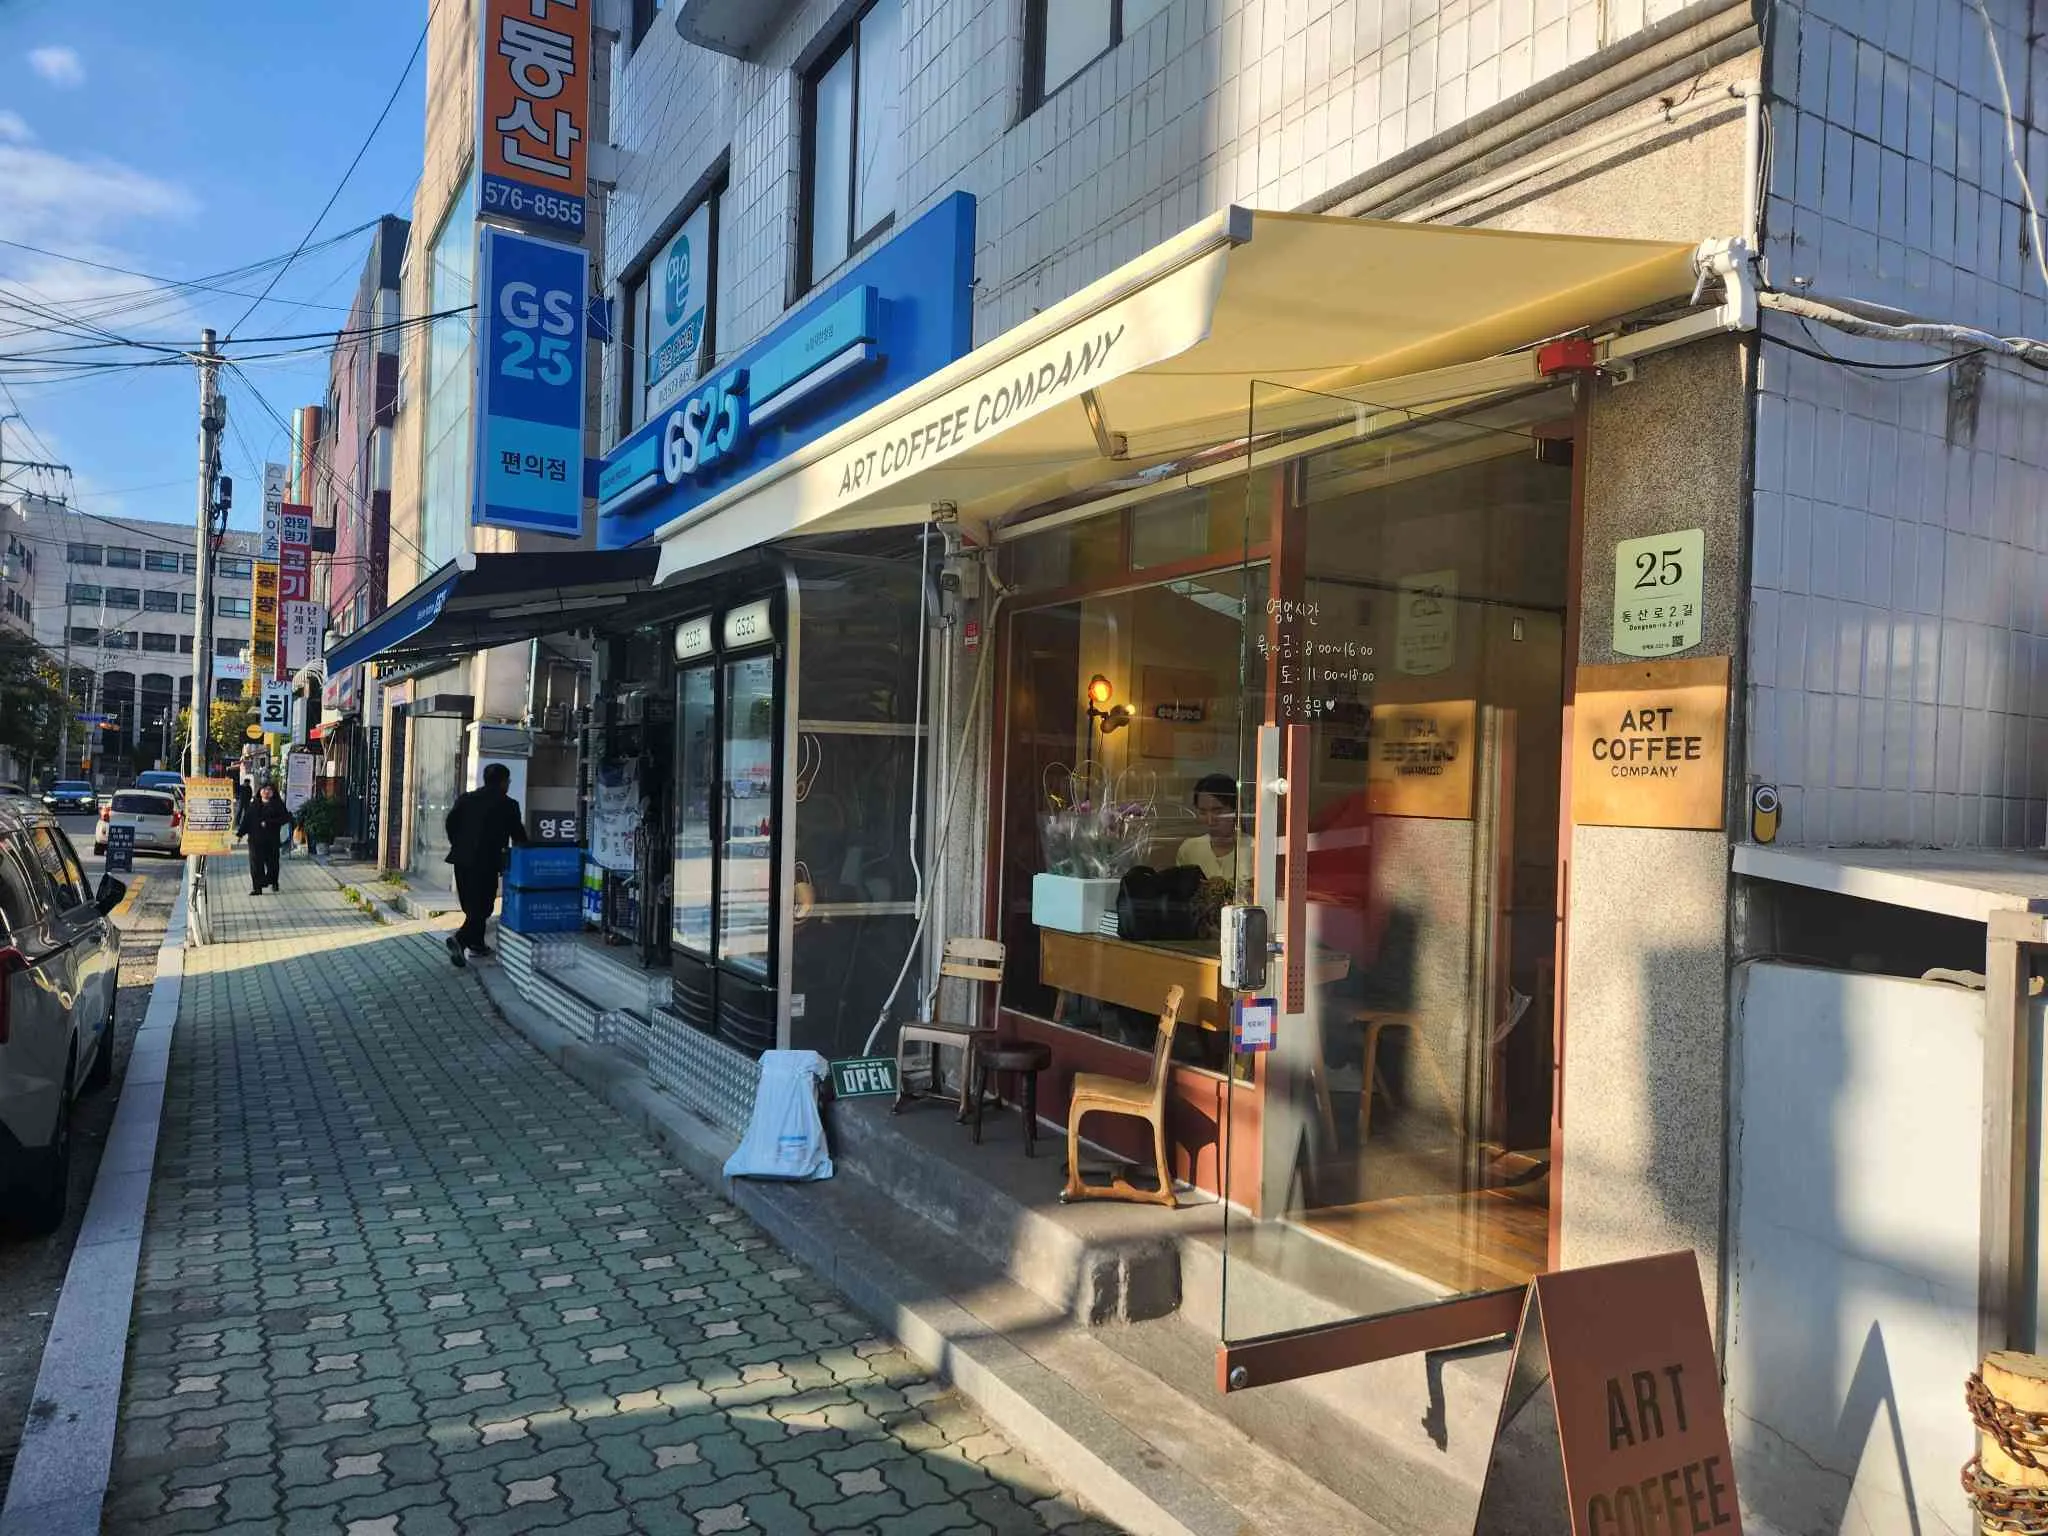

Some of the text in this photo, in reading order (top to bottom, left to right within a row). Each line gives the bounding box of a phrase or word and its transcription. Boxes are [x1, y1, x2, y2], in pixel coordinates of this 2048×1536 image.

[484, 181, 582, 225] 576-8555
[500, 281, 575, 336] GS
[500, 330, 573, 386] 25
[664, 367, 741, 485] GS25
[838, 324, 1125, 498] ART COFFEE COMPANY
[501, 449, 567, 483] 편의점
[1634, 547, 1683, 590] 25
[736, 615, 757, 638] GS25
[1266, 597, 1320, 626] 영업시간
[1619, 708, 1673, 733] ART
[1592, 736, 1702, 761] COFFEE
[1611, 765, 1678, 778] COMPANY
[843, 1066, 893, 1093] OPEN
[1606, 1363, 1688, 1451] ART
[1588, 1455, 1732, 1536] COFFEE
